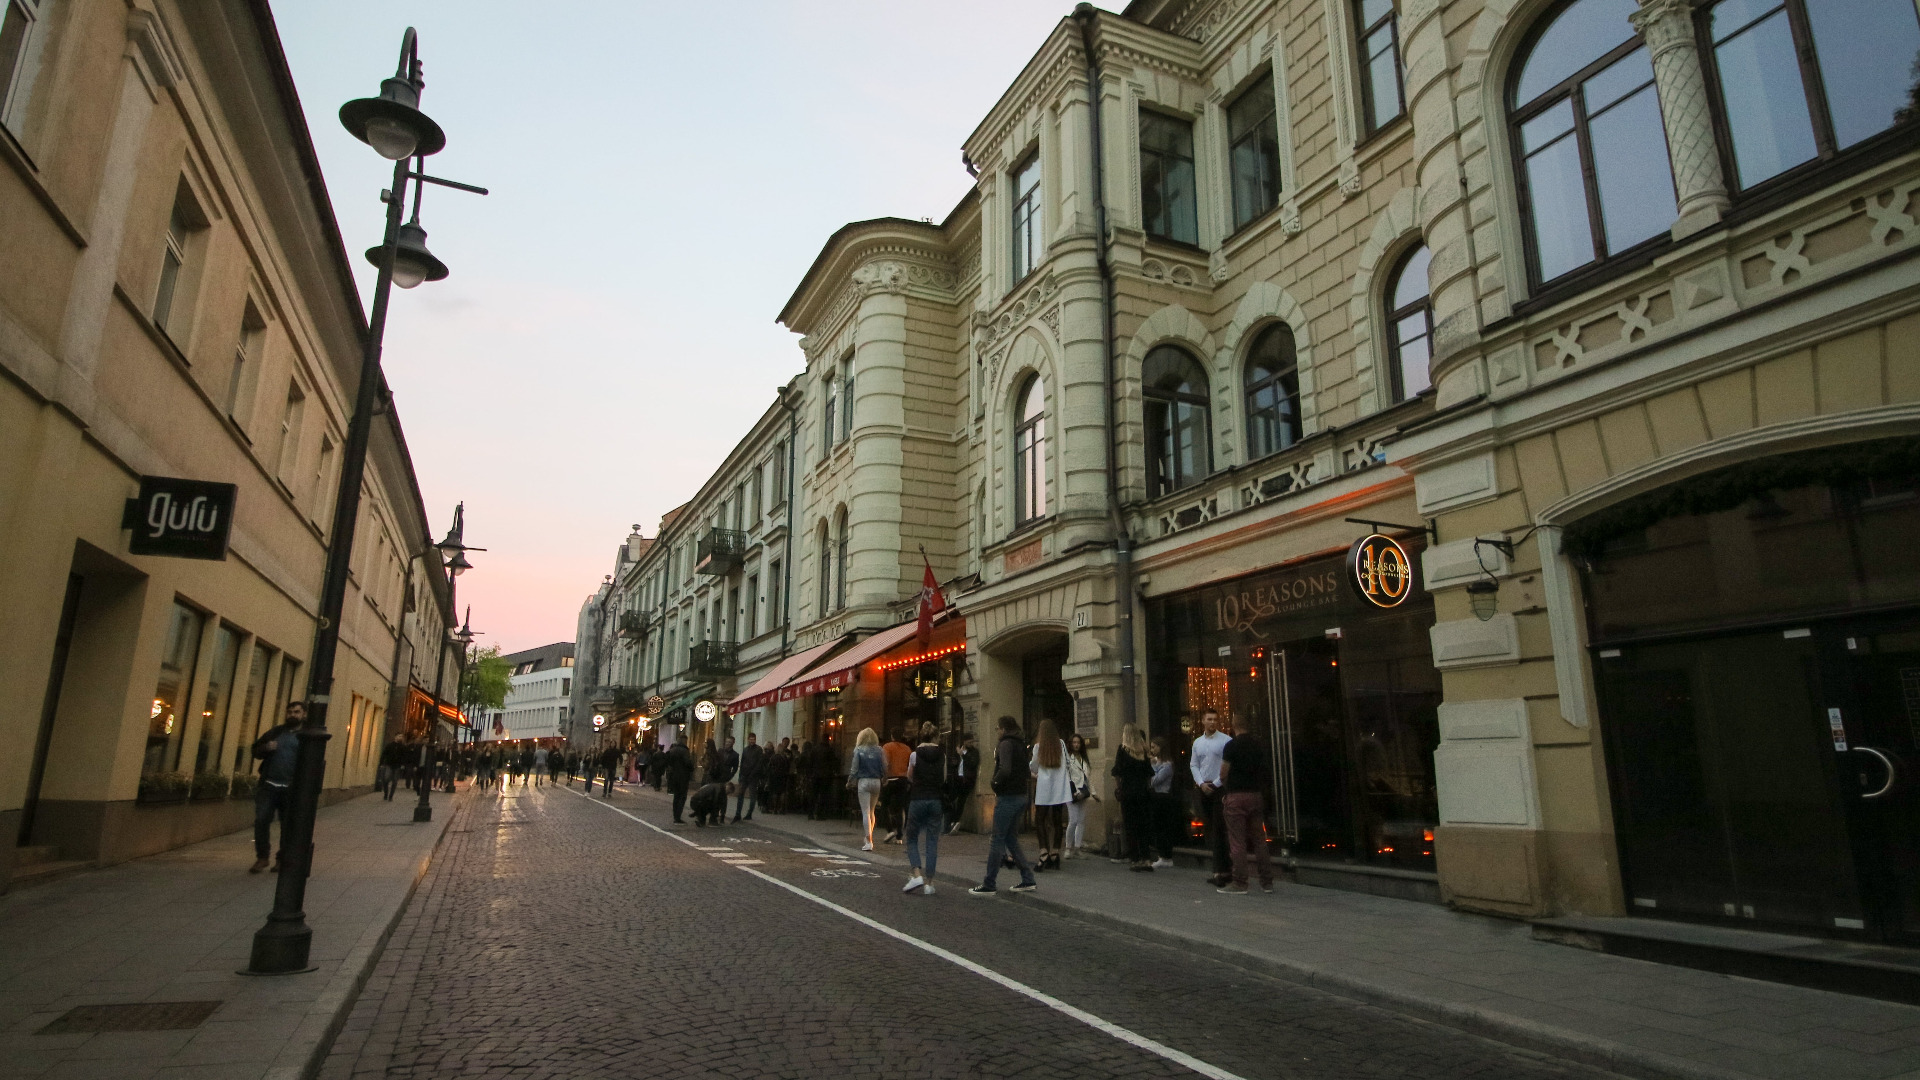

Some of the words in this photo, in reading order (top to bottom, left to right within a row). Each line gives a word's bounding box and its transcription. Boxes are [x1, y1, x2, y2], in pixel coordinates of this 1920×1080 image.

[148, 492, 218, 538] guru
[1361, 559, 1409, 582] REASONS
[1363, 544, 1406, 598] 10
[1077, 612, 1085, 626] 27
[1238, 571, 1337, 636] REASONS
[1277, 599, 1315, 614] LOUNGE
[1318, 594, 1339, 606] BAR
